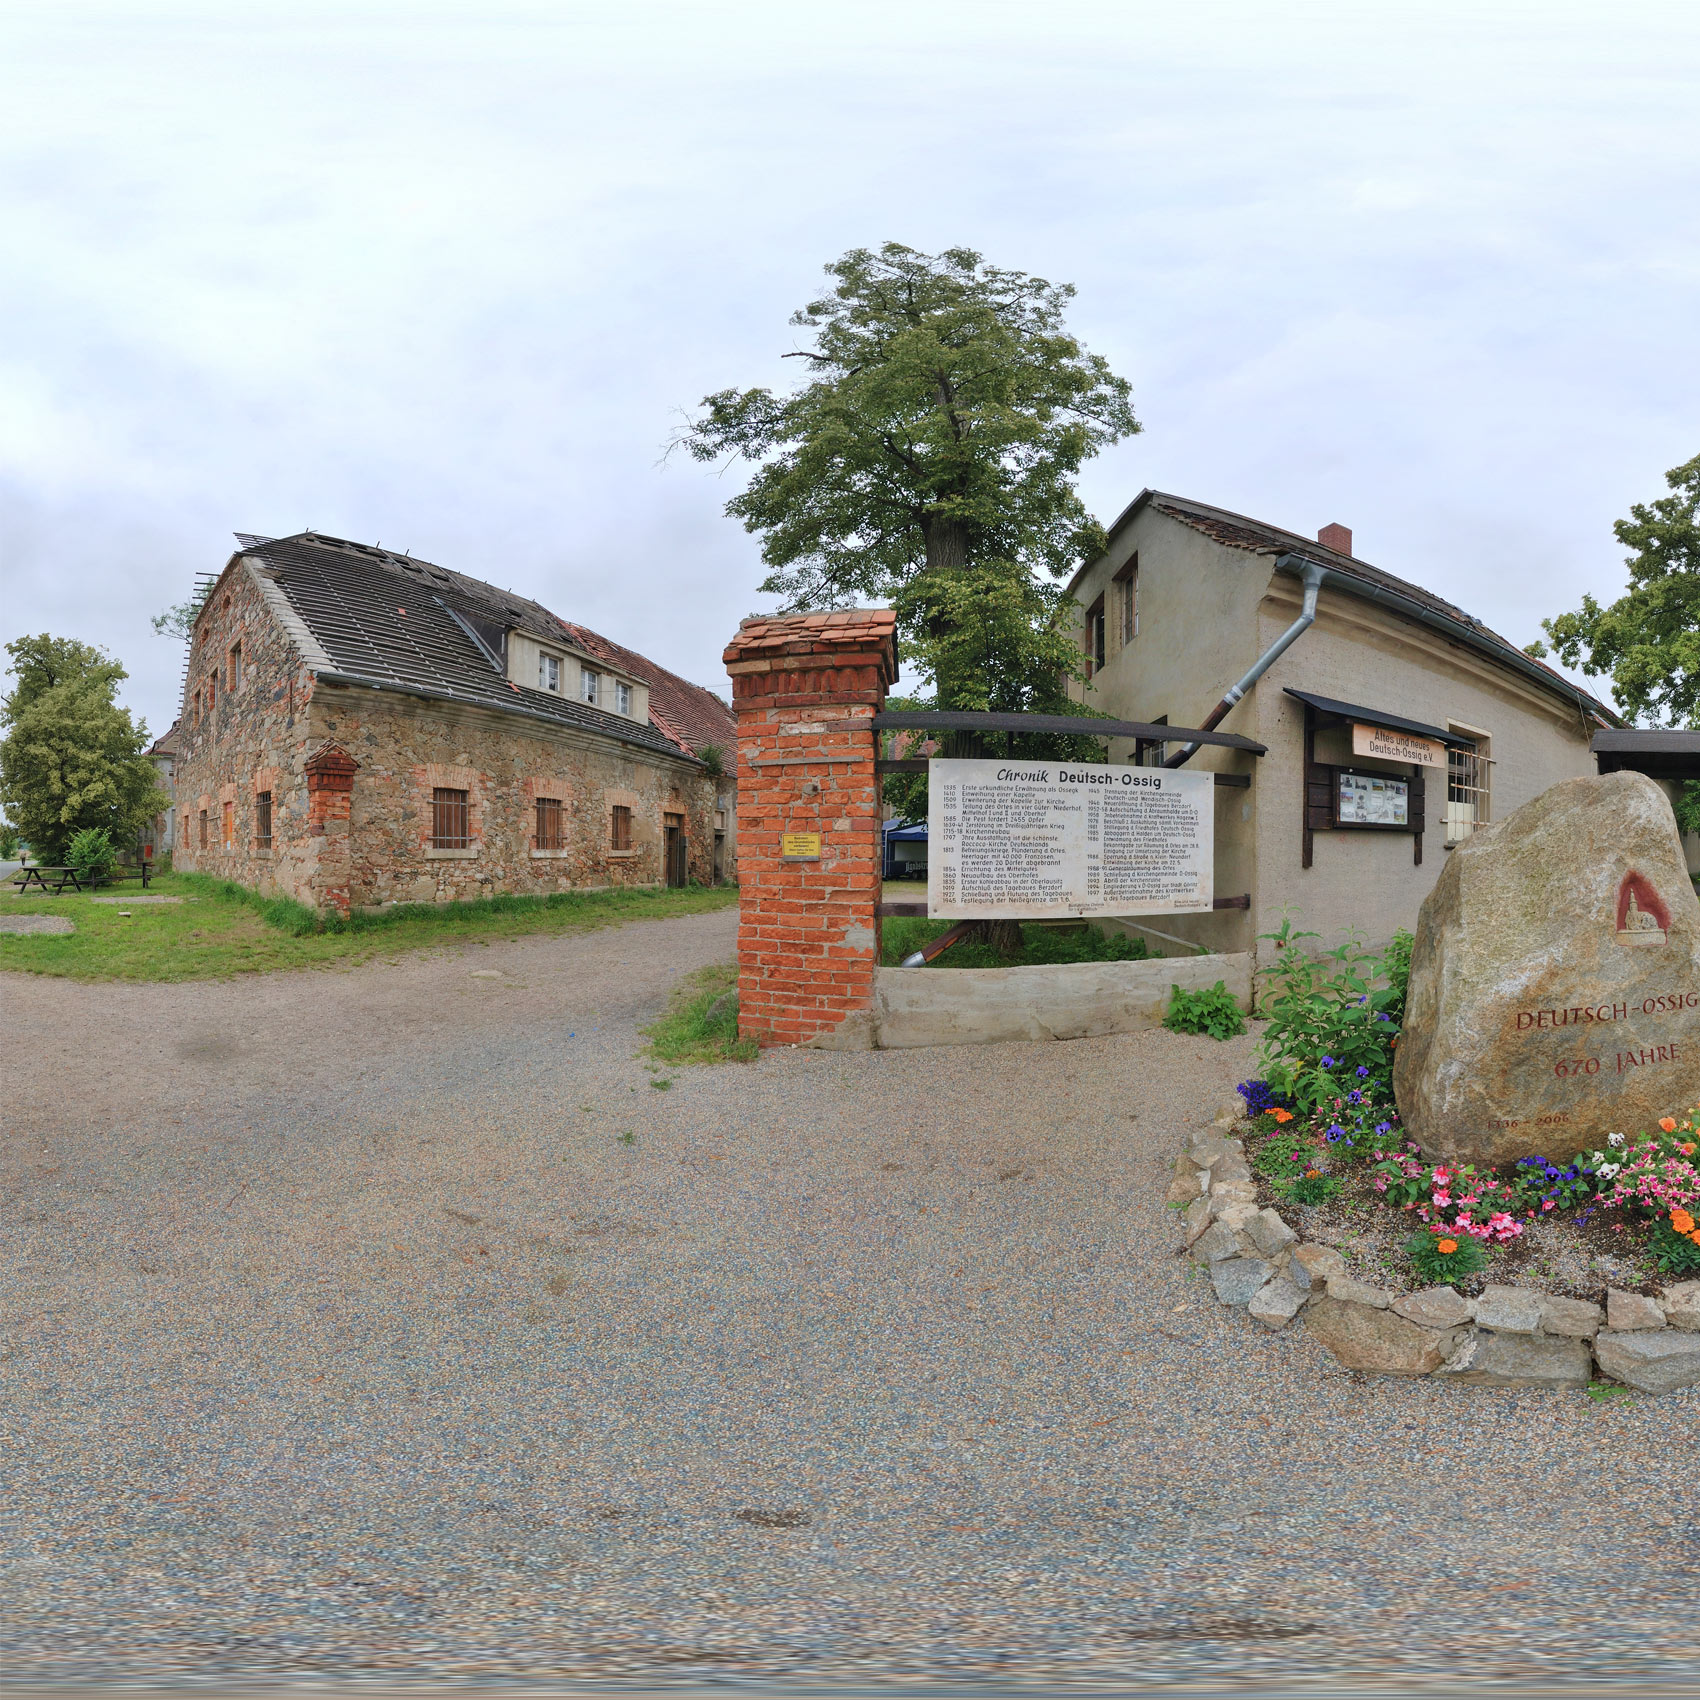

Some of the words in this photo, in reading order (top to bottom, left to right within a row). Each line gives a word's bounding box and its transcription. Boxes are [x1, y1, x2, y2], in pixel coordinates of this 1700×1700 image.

[1375, 729, 1395, 744] Altes
[1396, 737, 1409, 747] und
[1410, 740, 1430, 751] neues
[1369, 741, 1422, 762] Deutsch-Ossig
[1423, 752, 1434, 762] e.V.
[997, 768, 1049, 783] Chronik
[1516, 991, 1699, 1031] DEUTSCH-OSSIG
[1553, 1057, 1600, 1078] 670
[1616, 1043, 1680, 1075] JAHRE
